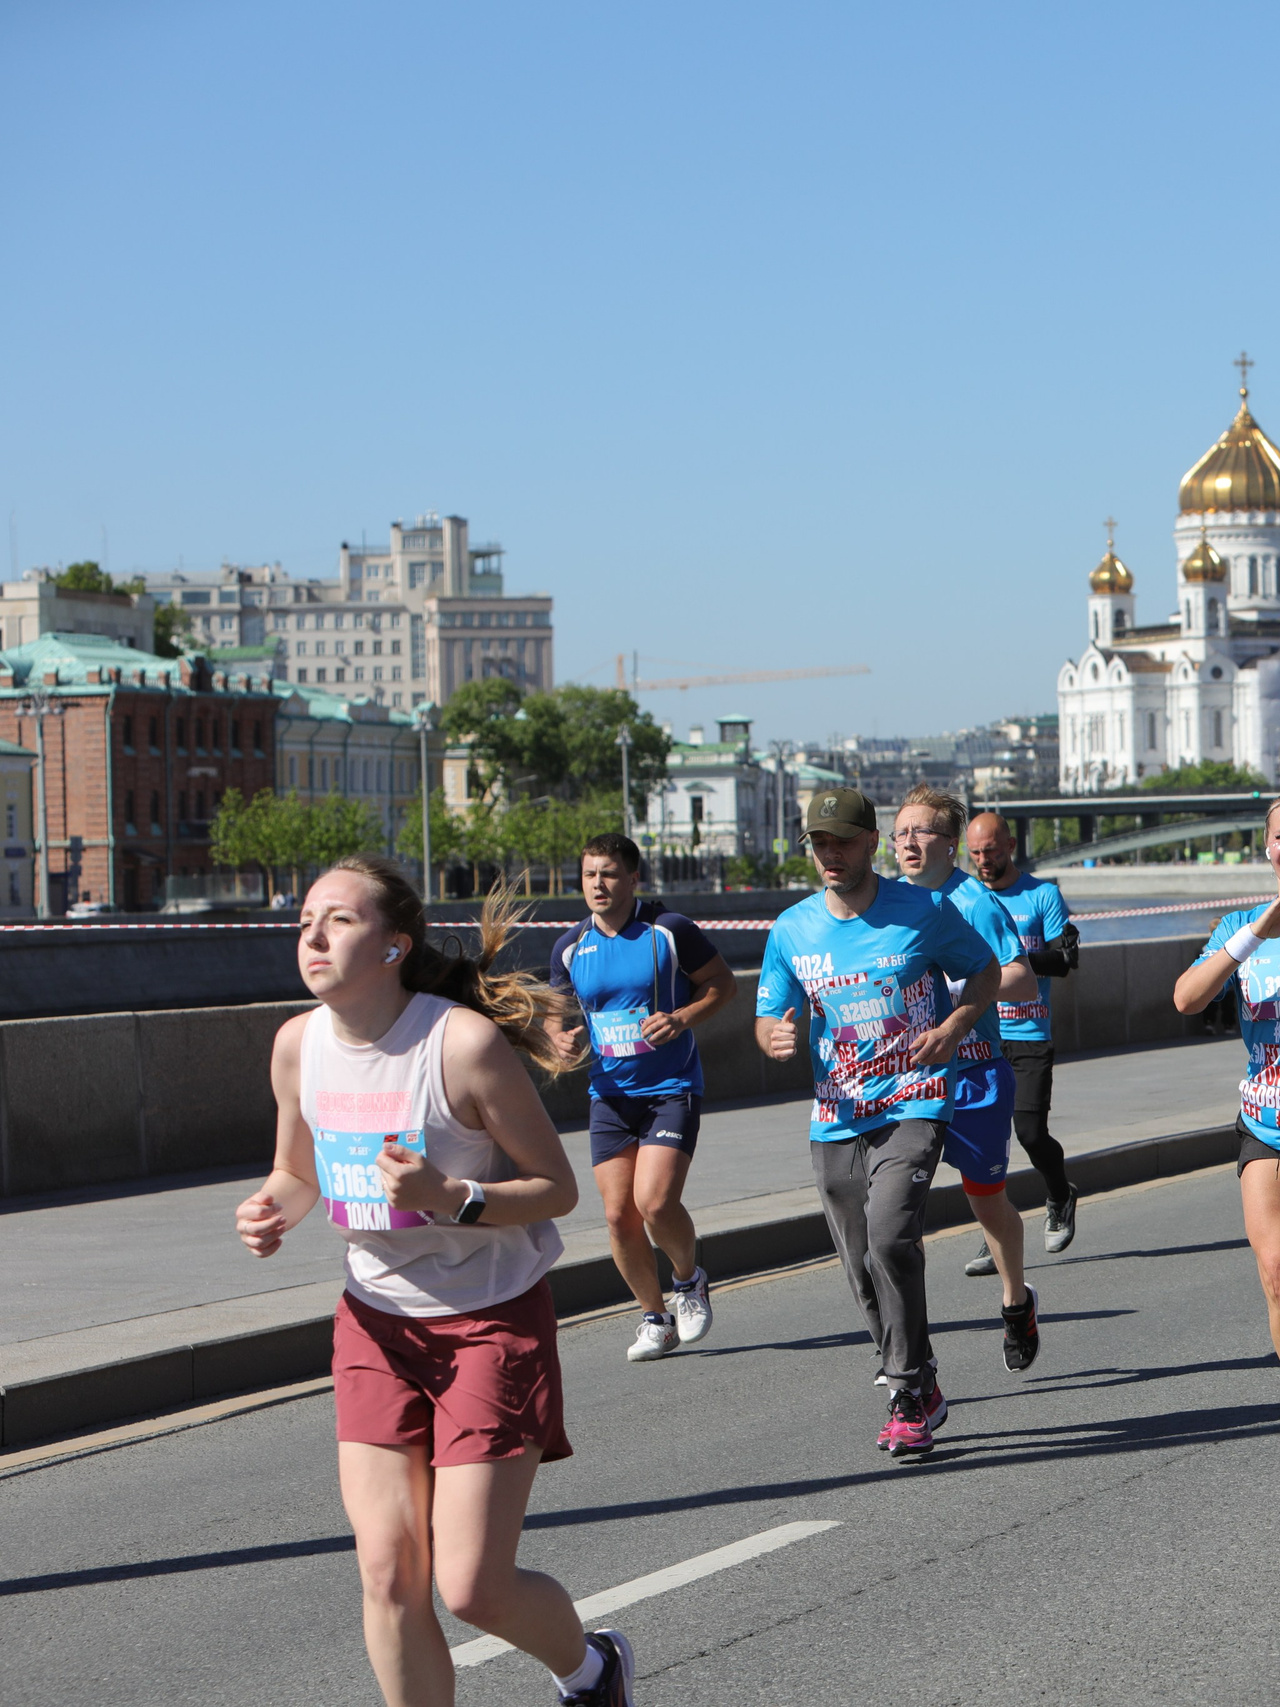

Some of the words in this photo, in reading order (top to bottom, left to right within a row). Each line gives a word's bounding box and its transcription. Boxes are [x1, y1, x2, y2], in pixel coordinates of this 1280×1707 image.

[792, 952, 834, 980] 2024
[839, 997, 889, 1024] 32601
[602, 1023, 640, 1043] 34772
[853, 1019, 887, 1041] 10KM
[611, 1042, 636, 1057] 10KM
[357, 1091, 411, 1112] RUNNING
[665, 1130, 683, 1140] asics
[332, 1162, 385, 1198] 3163
[344, 1202, 391, 1230] 10KM
